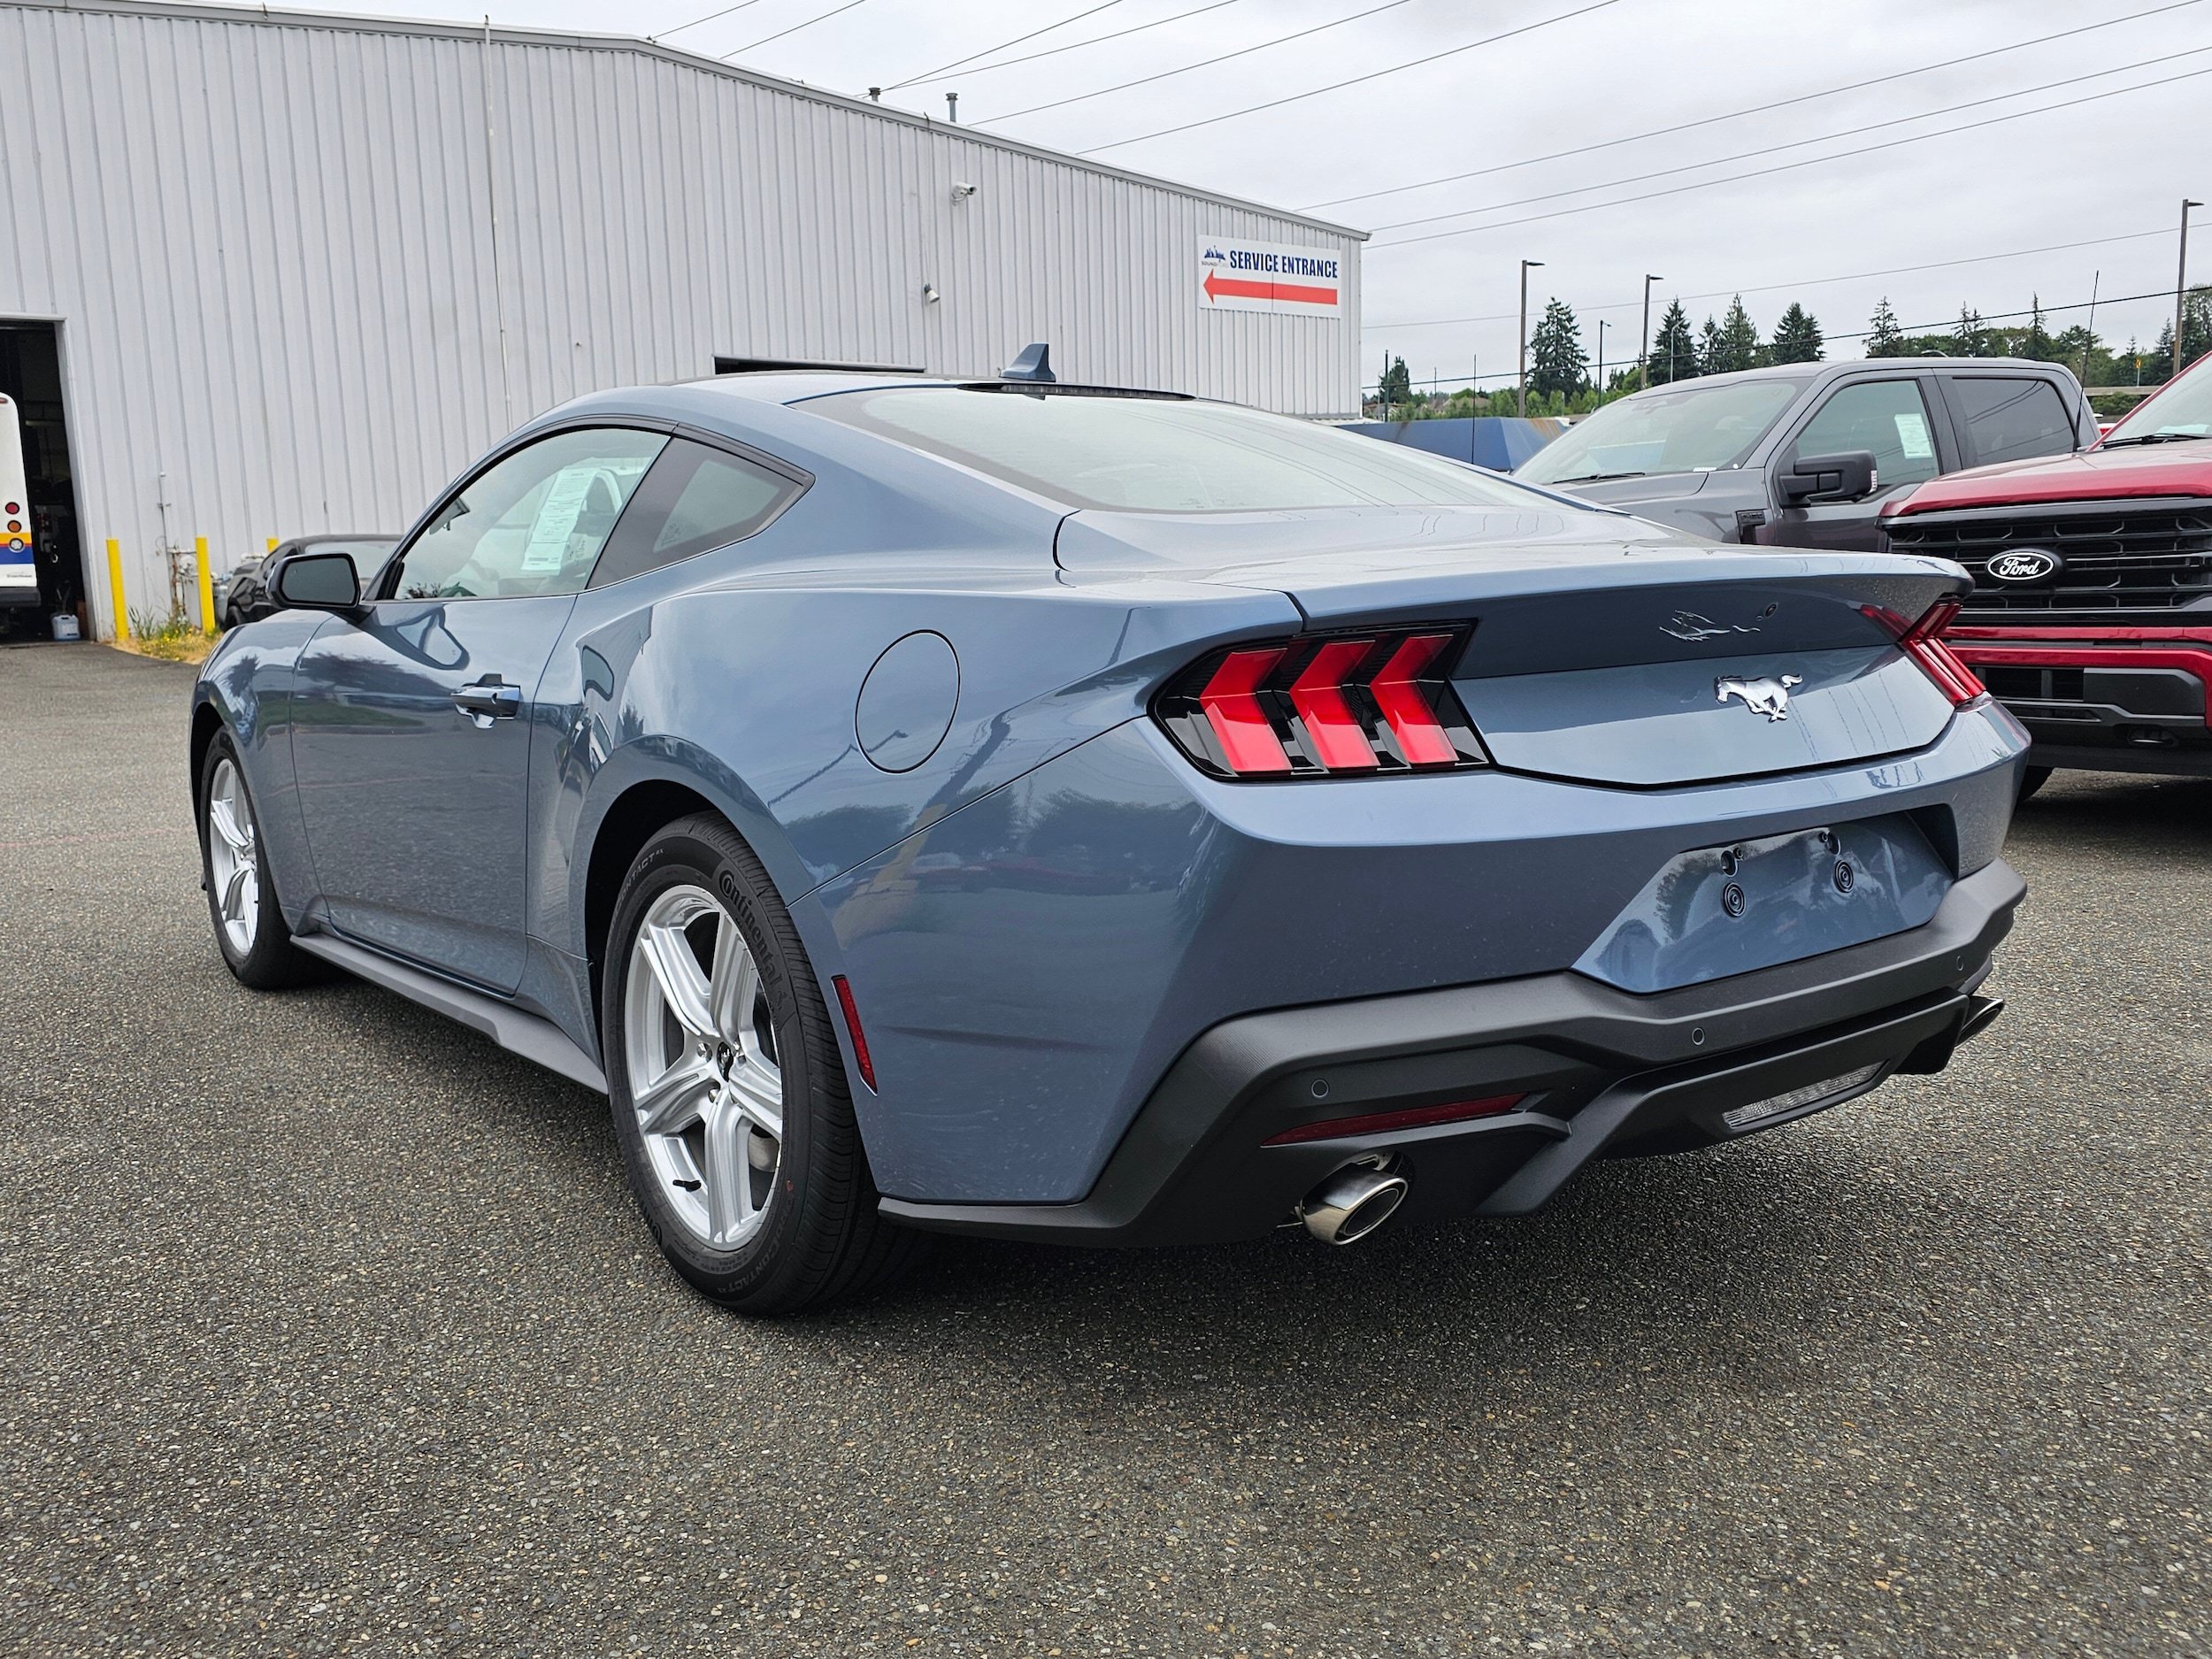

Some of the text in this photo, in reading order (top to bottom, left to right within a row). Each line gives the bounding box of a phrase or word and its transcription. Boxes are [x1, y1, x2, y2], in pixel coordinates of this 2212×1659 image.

[1230, 250, 1338, 279] SERVICE ENTRANCE
[1999, 557, 2040, 575] Ford
[718, 870, 783, 986] Continental
